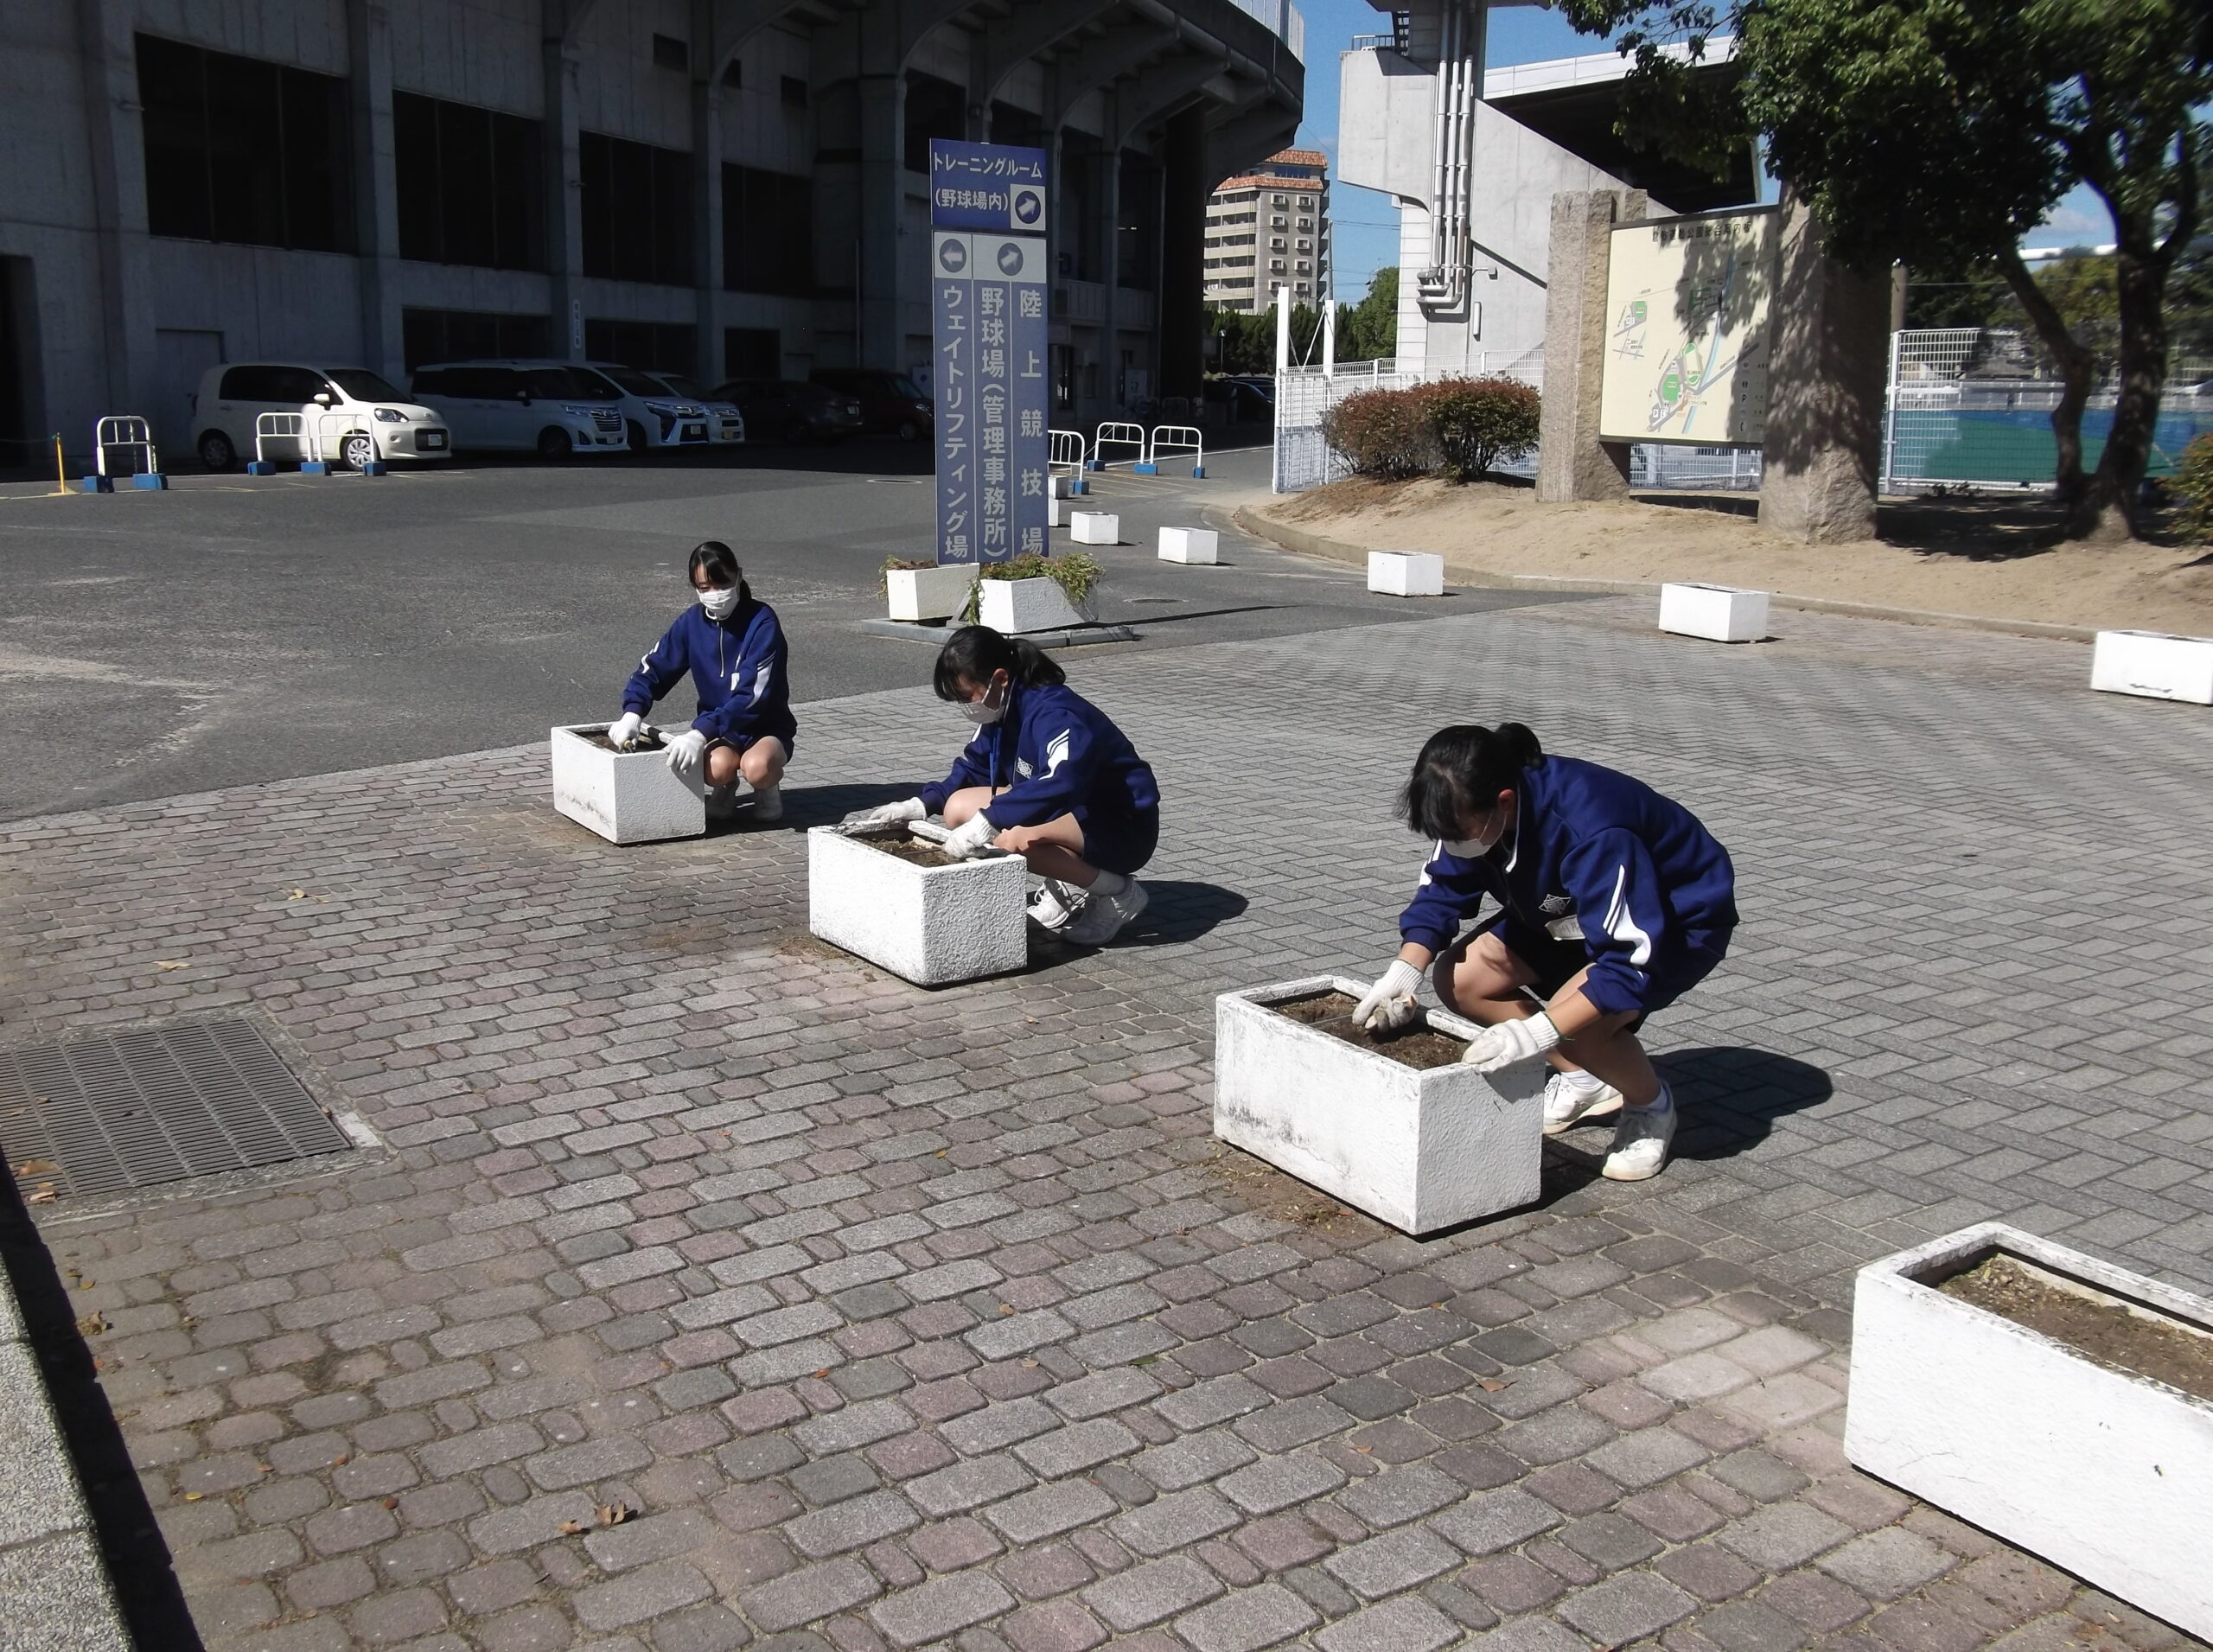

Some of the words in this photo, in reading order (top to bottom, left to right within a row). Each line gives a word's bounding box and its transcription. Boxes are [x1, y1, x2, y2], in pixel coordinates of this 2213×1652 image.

[934, 152, 1043, 179] トレーニングルーム
[943, 285, 969, 558] ウェイトリフティング場
[981, 287, 1007, 558] 野球場（管理事務所）
[1020, 290, 1044, 556] 陸上競技場
